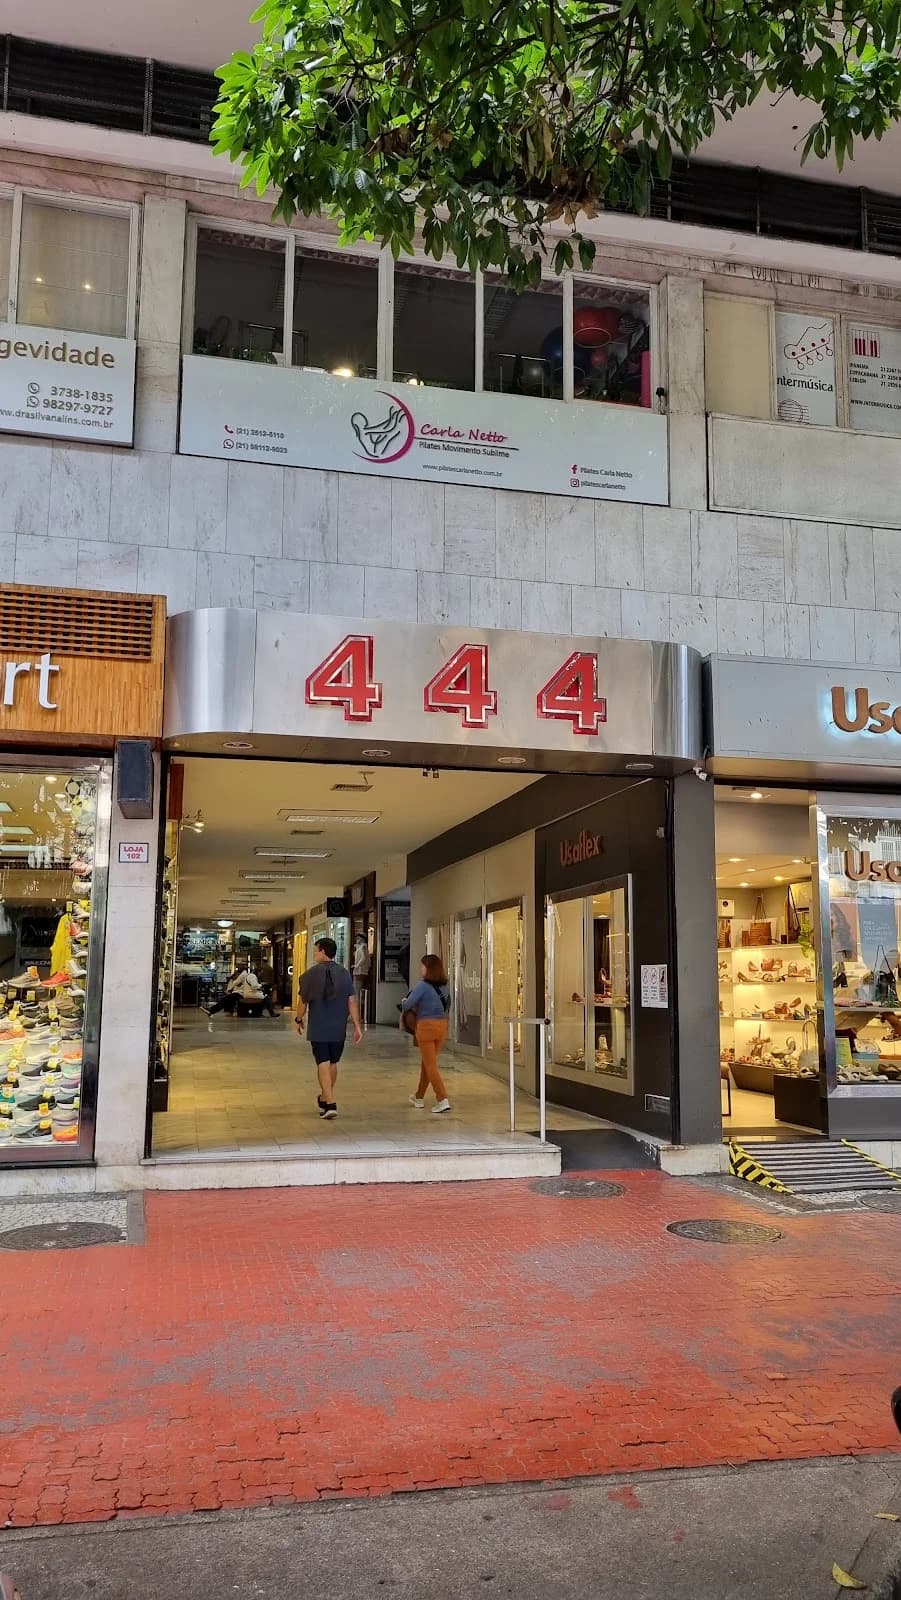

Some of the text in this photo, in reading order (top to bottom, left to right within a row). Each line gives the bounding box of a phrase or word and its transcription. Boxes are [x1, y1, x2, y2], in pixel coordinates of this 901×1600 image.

[50, 386, 113, 403] 3738-1835
[42, 398, 114, 416] 98297-9727
[420, 423, 509, 443] Carla Netto
[419, 441, 510, 458] Pilates Movimento Sublime
[580, 467, 633, 479] Pilates Carla Netto
[3, 653, 60, 709] rt
[559, 831, 601, 867] Usaflex
